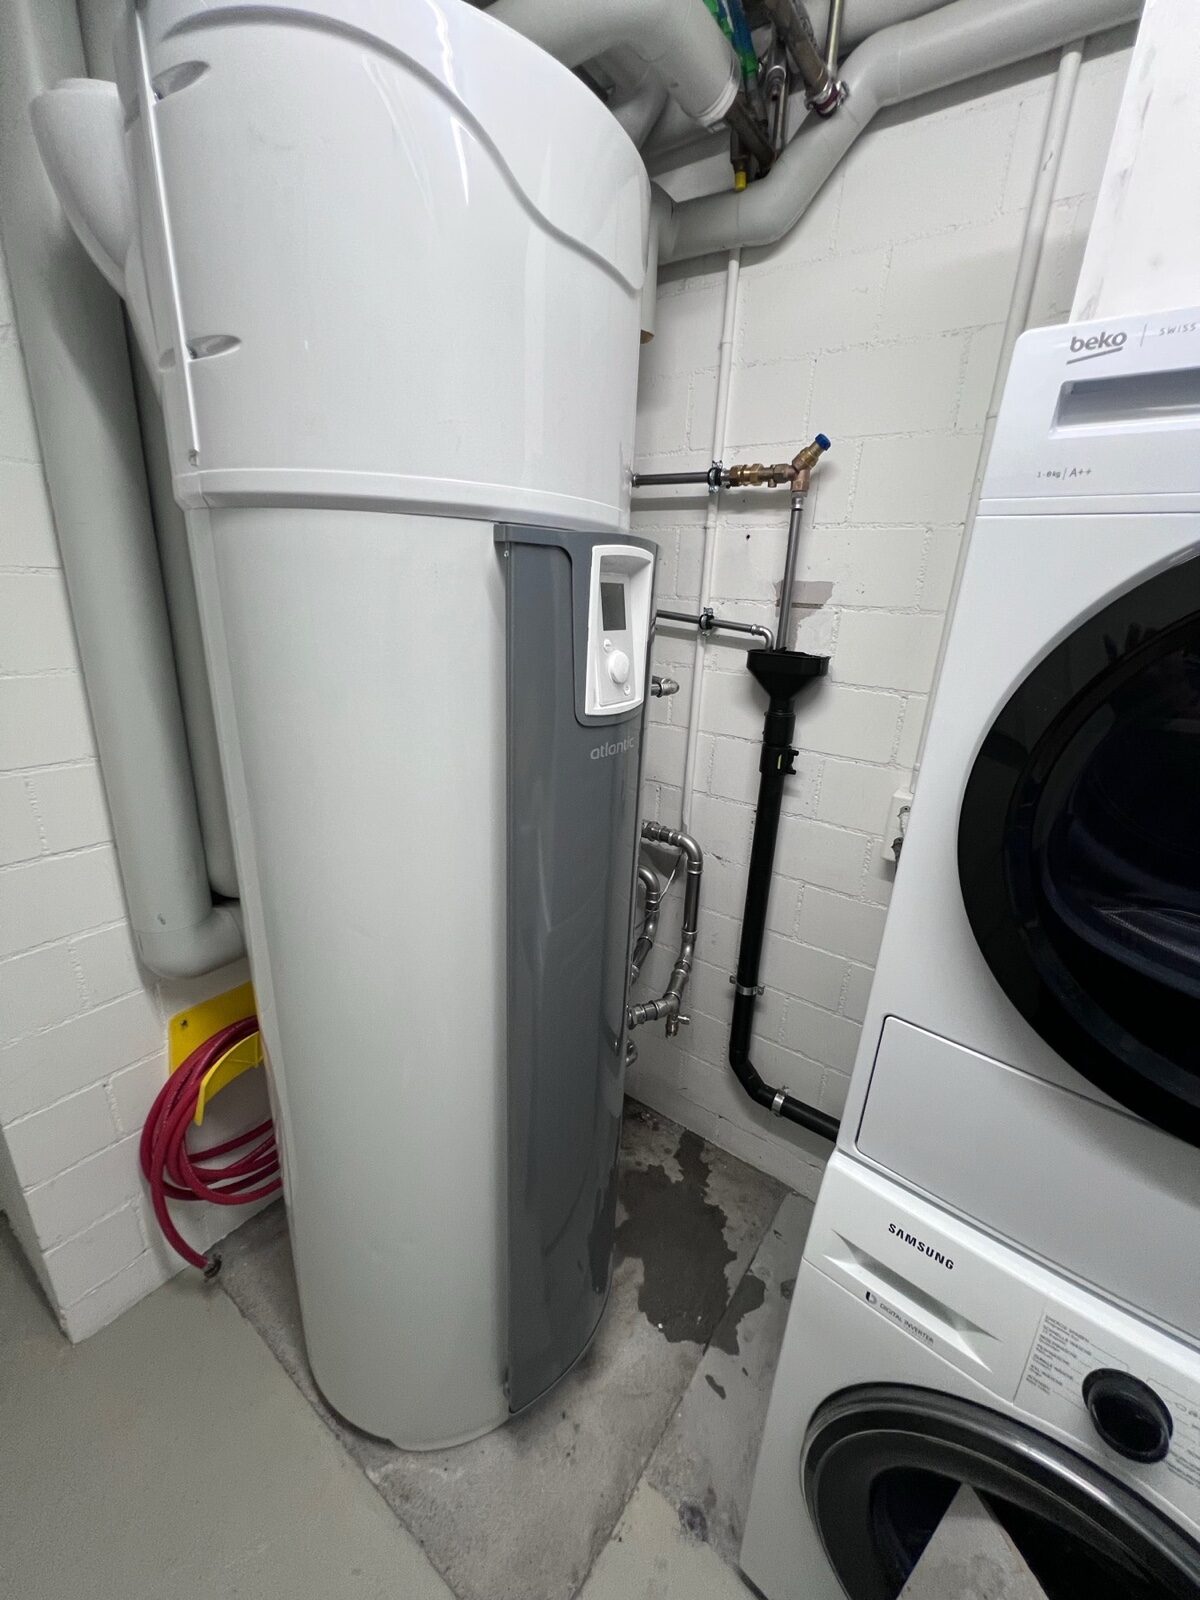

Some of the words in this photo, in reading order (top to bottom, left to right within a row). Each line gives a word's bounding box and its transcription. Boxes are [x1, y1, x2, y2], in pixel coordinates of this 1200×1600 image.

[1069, 331, 1127, 353] beko
[1159, 322, 1197, 336] SWISS
[1069, 467, 1092, 478] A++
[590, 735, 635, 760] atlantic
[888, 1223, 955, 1270] SAMSUNG
[879, 1303, 902, 1322] DIGITAL
[904, 1319, 934, 1344] INVERTER
